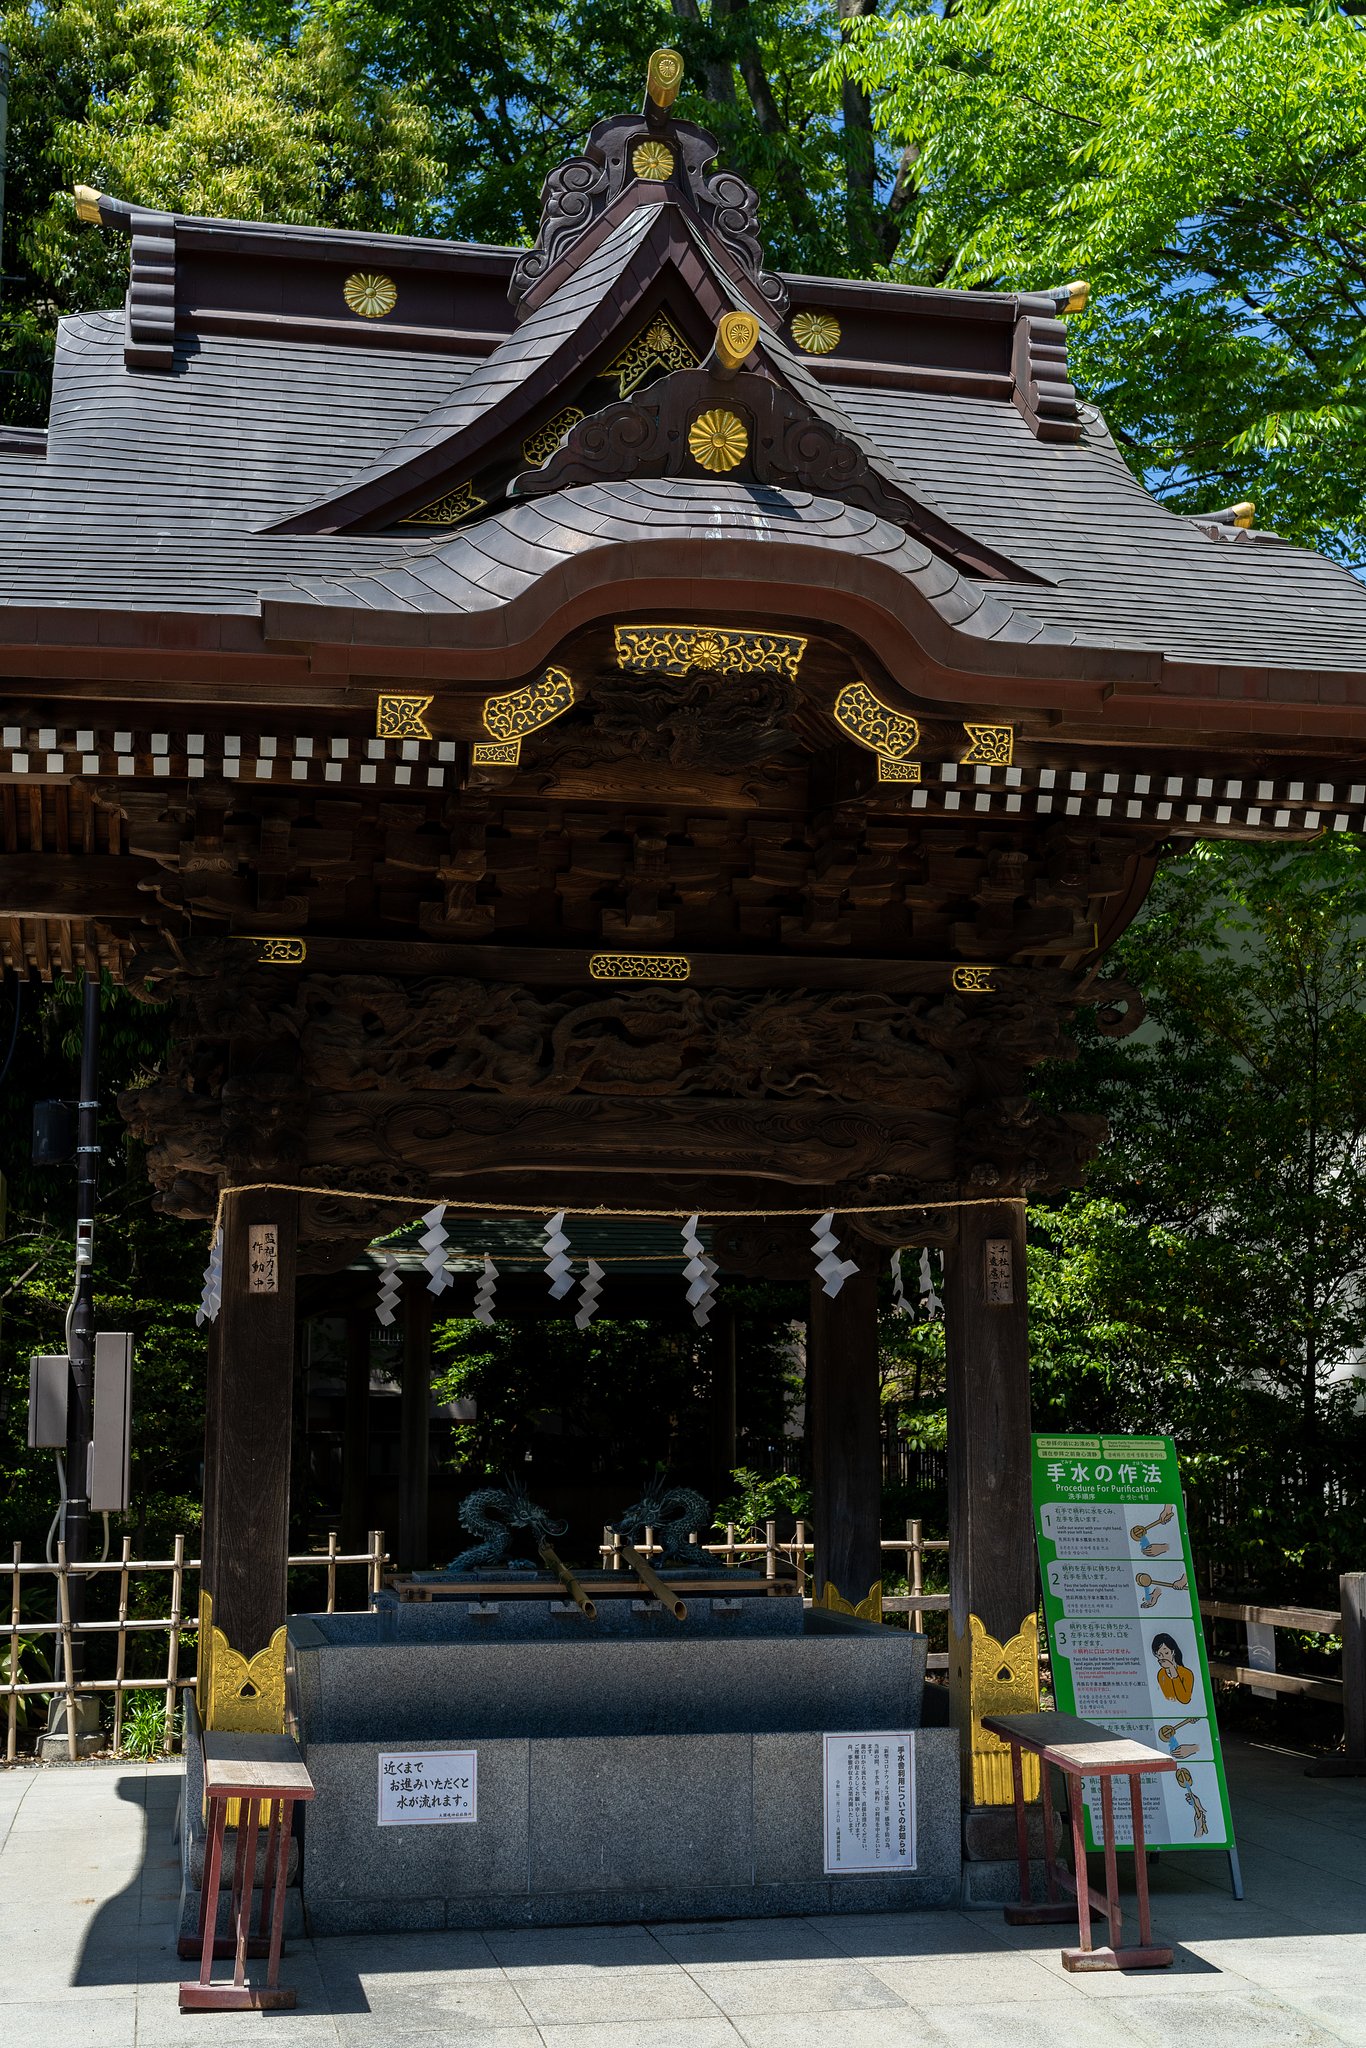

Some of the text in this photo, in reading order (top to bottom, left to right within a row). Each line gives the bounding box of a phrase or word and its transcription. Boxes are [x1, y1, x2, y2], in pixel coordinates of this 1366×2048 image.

[251, 1241, 265, 1288] 作動中
[264, 1232, 277, 1290] 監視カメラ
[1047, 1463, 1162, 1484] 手水の作法
[1055, 1483, 1158, 1493] Procedure For Purification.
[1045, 1515, 1051, 1526] 1
[1051, 1573, 1060, 1585] 2
[1058, 1632, 1067, 1644] 3
[383, 1761, 424, 1775] 近くまで
[389, 1777, 469, 1792] お進みいただくと
[396, 1794, 468, 1809] 水が流れます。
[897, 1746, 906, 1856] 手水舎利用についてのお知らせ
